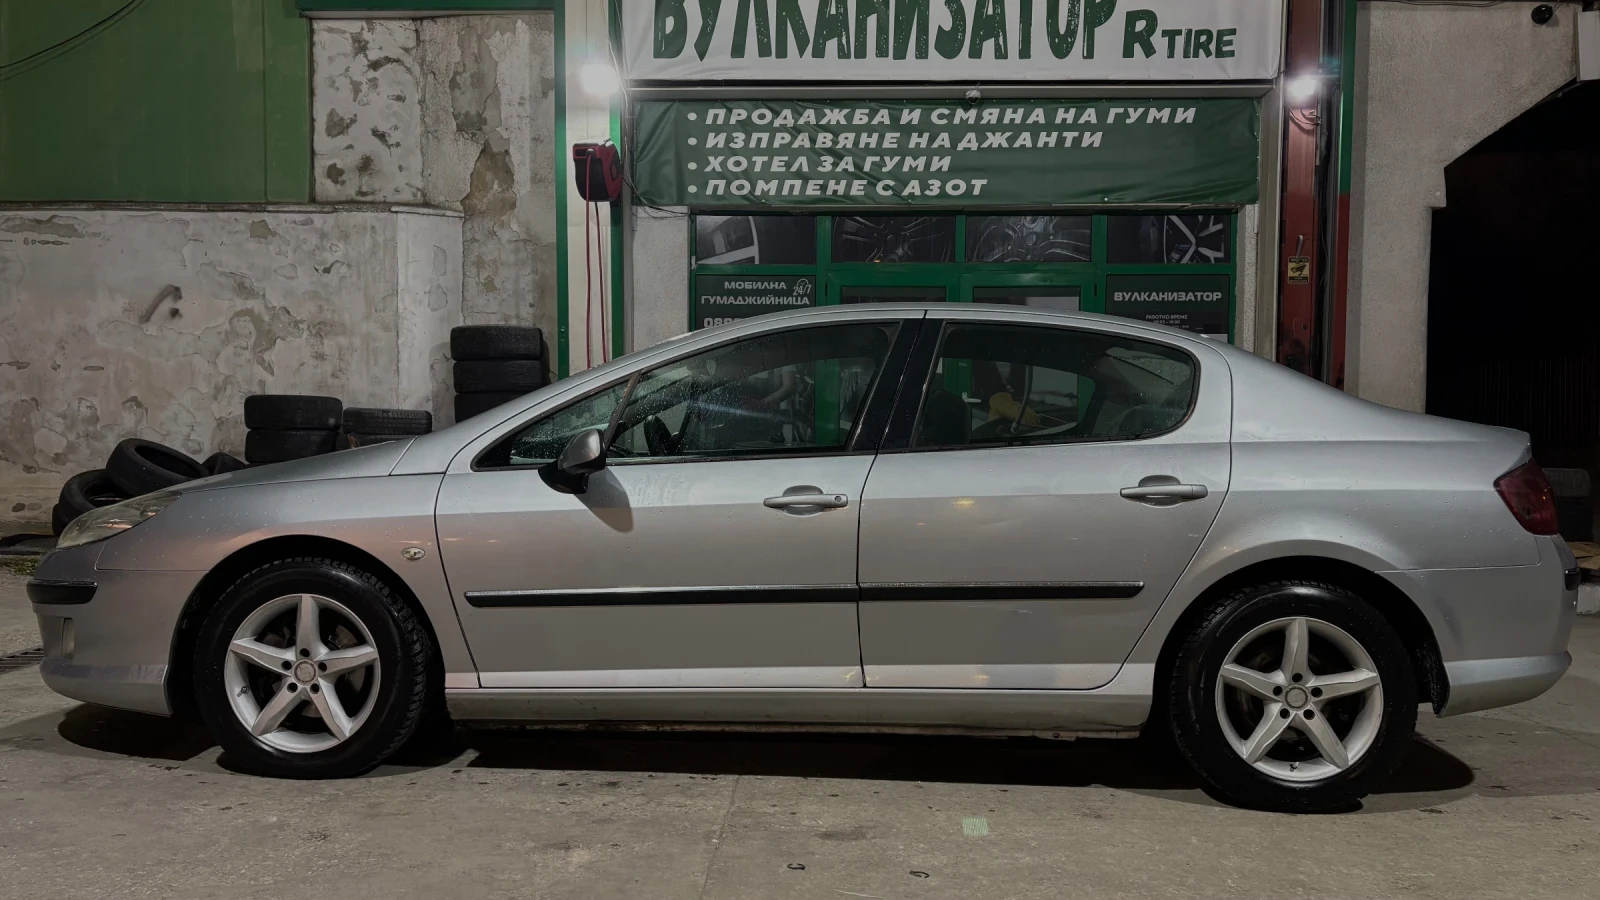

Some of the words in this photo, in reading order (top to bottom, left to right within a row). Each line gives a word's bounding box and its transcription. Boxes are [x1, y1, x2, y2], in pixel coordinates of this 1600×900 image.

[1123, 9, 1158, 59] R
[1161, 28, 1237, 59] TIRE
[705, 108, 891, 127] ПРОДАЖБА
[900, 108, 922, 125] И
[931, 107, 1046, 125] СМЯНА
[1054, 107, 1098, 125] НА
[1106, 107, 1197, 124] ГУМИ
[705, 132, 901, 149] ИЗПРАВЯНЕ
[908, 132, 951, 148] НА
[956, 131, 1103, 150] ДЖАНТИ
[704, 156, 809, 172] ХОТЕЛ
[817, 156, 855, 172] ЗА
[863, 156, 952, 172] ГУМИ
[705, 179, 868, 196] ПОМПЕНЕ
[876, 179, 896, 196] С
[901, 179, 988, 196] АЗОТ
[724, 281, 787, 290] МОБИЛНА
[792, 284, 811, 295] 24/7
[701, 295, 810, 305] ГУМАДЖИЙНИЦА
[1114, 292, 1222, 301] ВУЛКАНИЗАТОР
